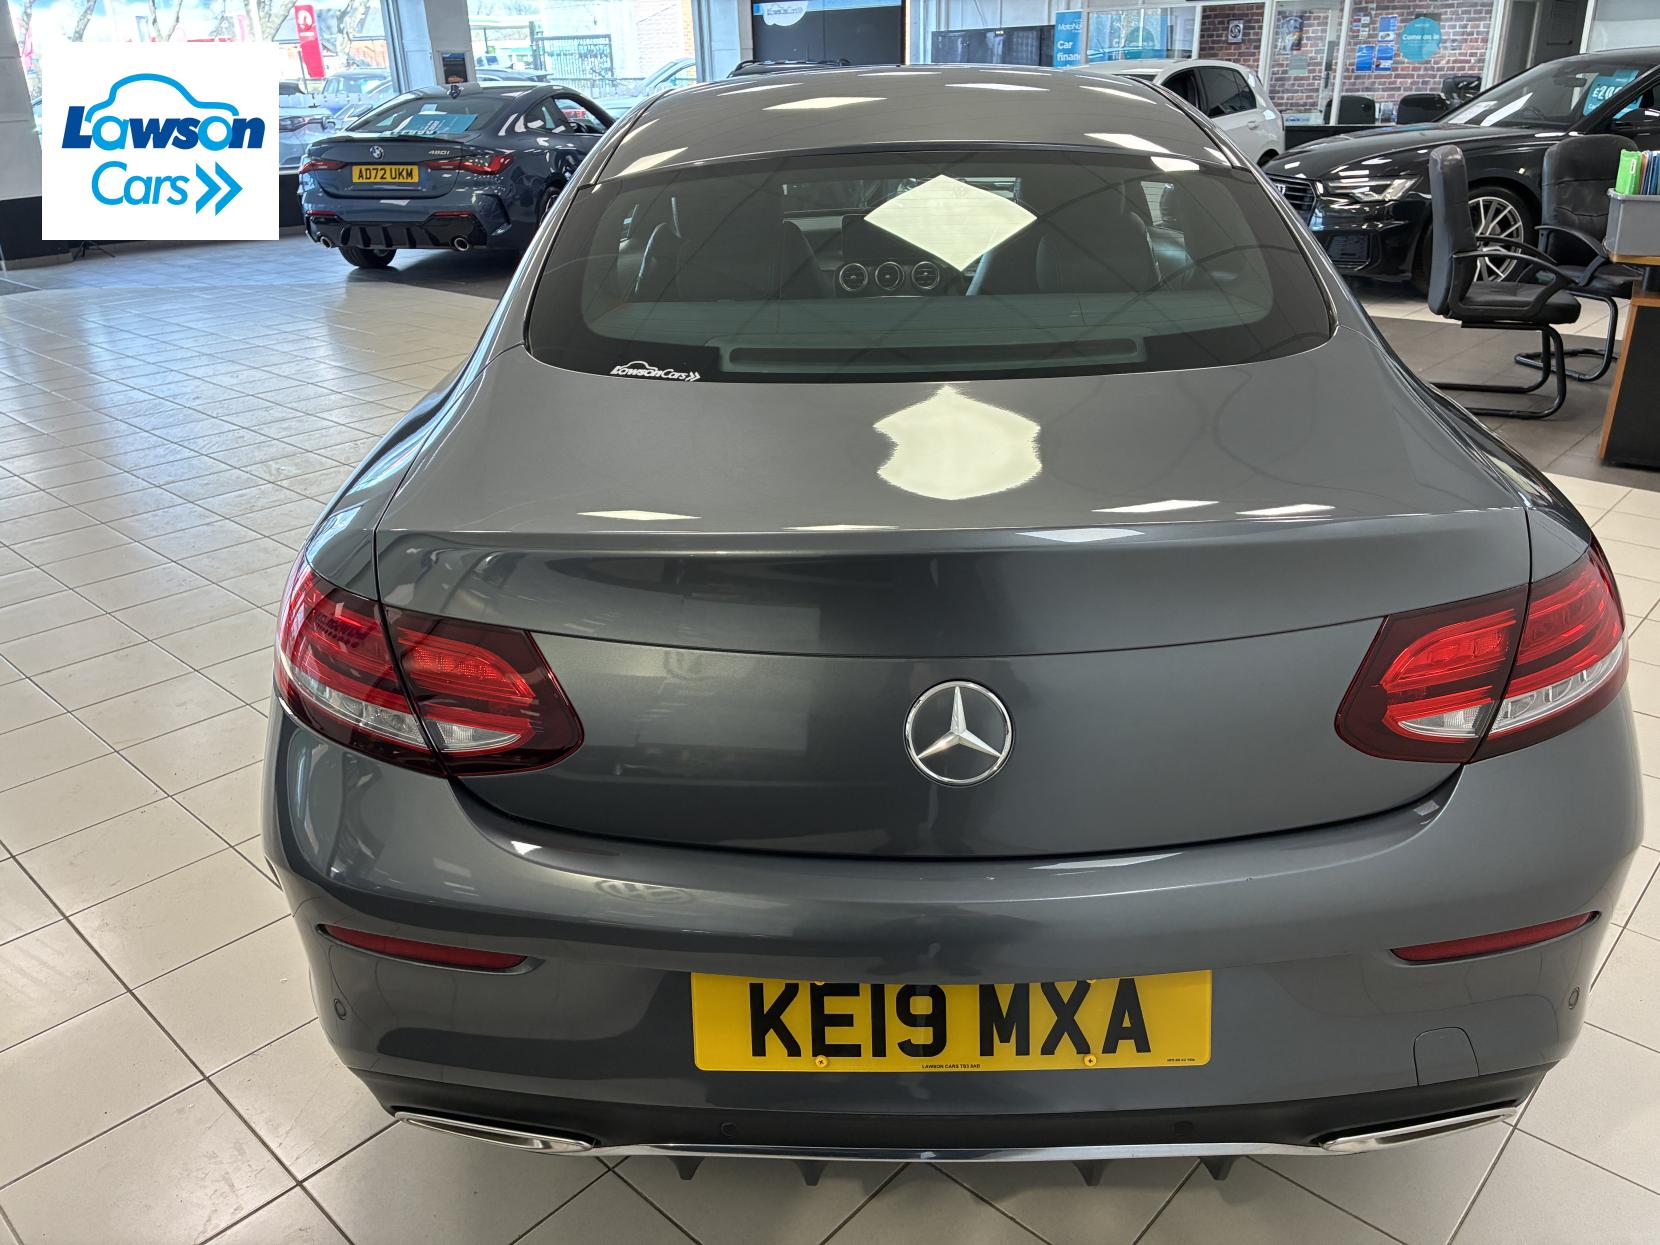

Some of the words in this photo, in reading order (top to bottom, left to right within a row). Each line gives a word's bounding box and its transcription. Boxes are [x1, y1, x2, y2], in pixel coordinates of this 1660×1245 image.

[1057, 40, 1073, 49] Car
[1057, 52, 1081, 61] finan
[358, 167, 387, 180] AD72
[390, 167, 414, 180] UKM
[748, 982, 948, 1058] KE19
[978, 978, 1152, 1056] MXA
